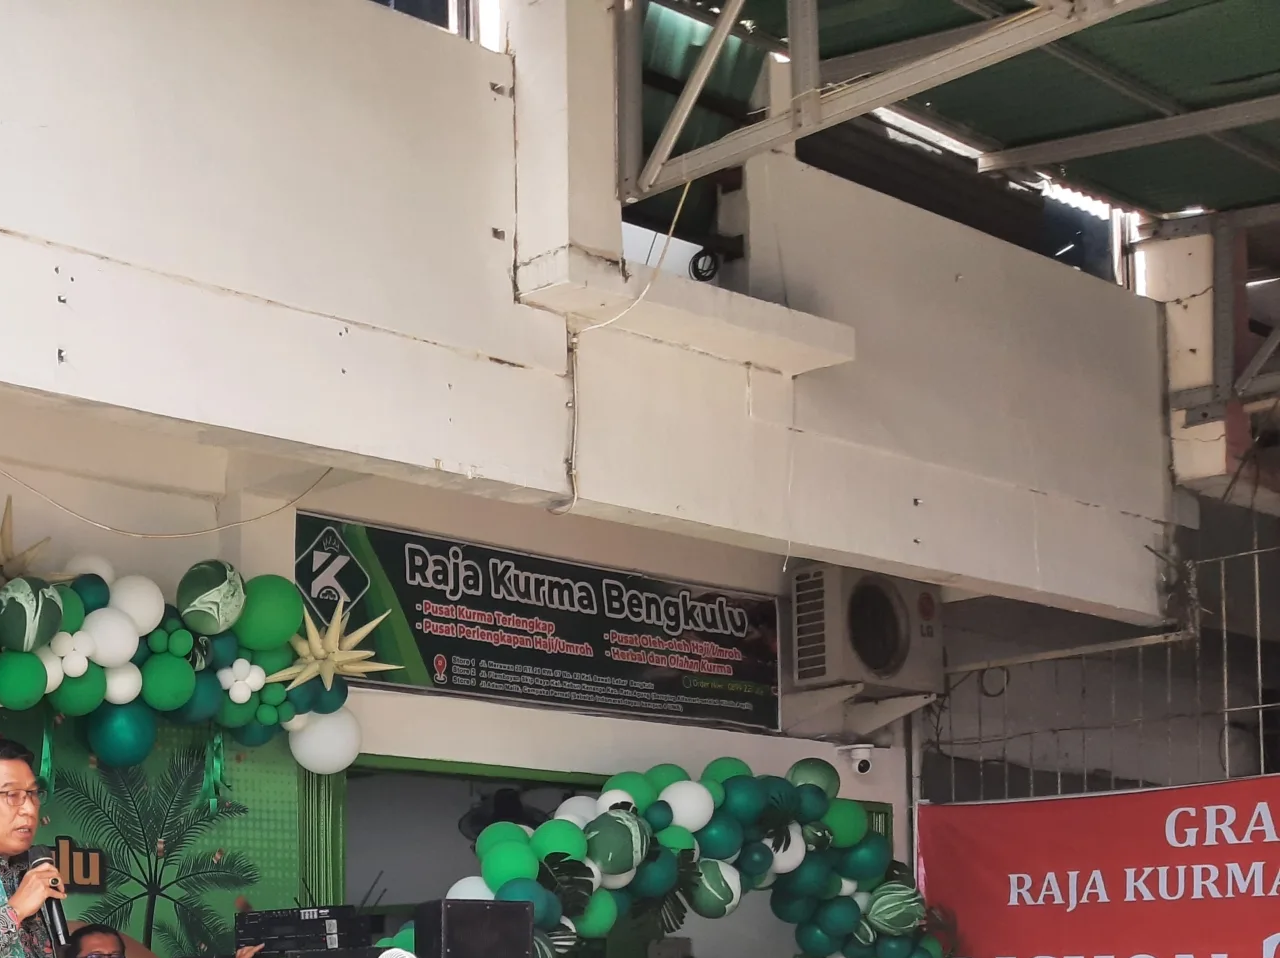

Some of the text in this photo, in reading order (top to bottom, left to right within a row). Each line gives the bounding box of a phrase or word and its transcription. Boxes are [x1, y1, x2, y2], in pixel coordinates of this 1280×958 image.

[405, 543, 748, 638] Raja Kurma Bengkulu
[422, 600, 555, 635] Pusat Kurma Terlengkap
[920, 624, 933, 638] LG
[423, 619, 593, 656] Pusat Perlengkapan Haji/Umroh
[610, 630, 742, 661] Pusat Oleh-oleh Haji/Umroh
[452, 655, 470, 666] Store
[452, 665, 470, 675] Store
[611, 647, 733, 676] Herbal dan Olahan Kurma
[452, 675, 470, 685] Store
[1165, 802, 1280, 847] GRA
[1007, 869, 1110, 912] RAJA
